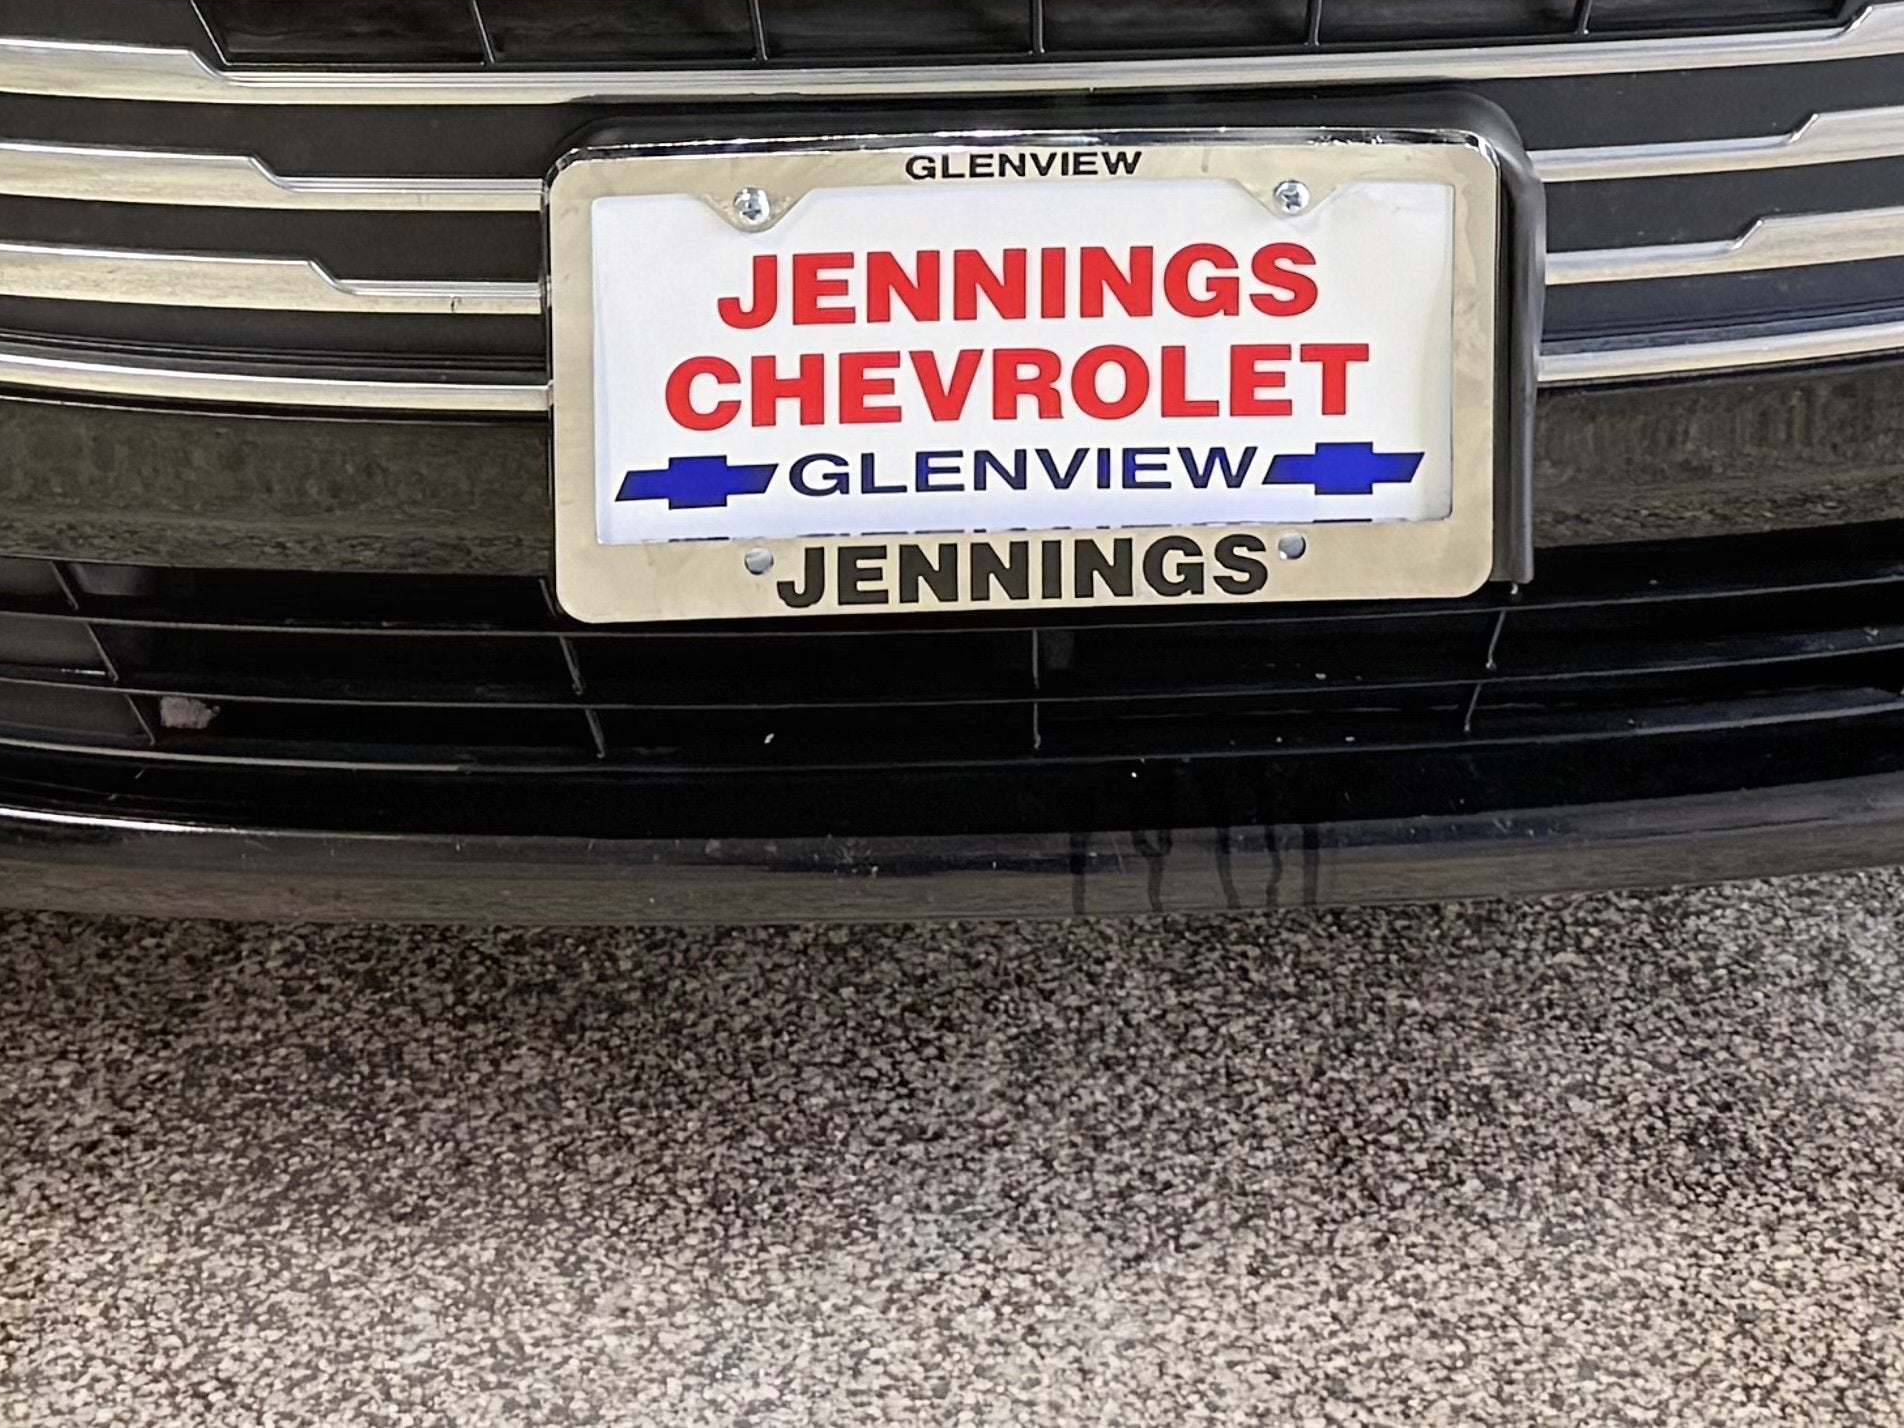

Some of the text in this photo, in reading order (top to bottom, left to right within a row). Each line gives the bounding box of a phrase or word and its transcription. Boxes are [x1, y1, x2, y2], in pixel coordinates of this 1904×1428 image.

[904, 150, 1143, 181] GLENVIEW
[718, 243, 1317, 330] JENNINGS
[666, 344, 1369, 432] CHEVROLET
[788, 445, 1258, 497] GLENVIEW
[776, 533, 1269, 609] JENNINGS
